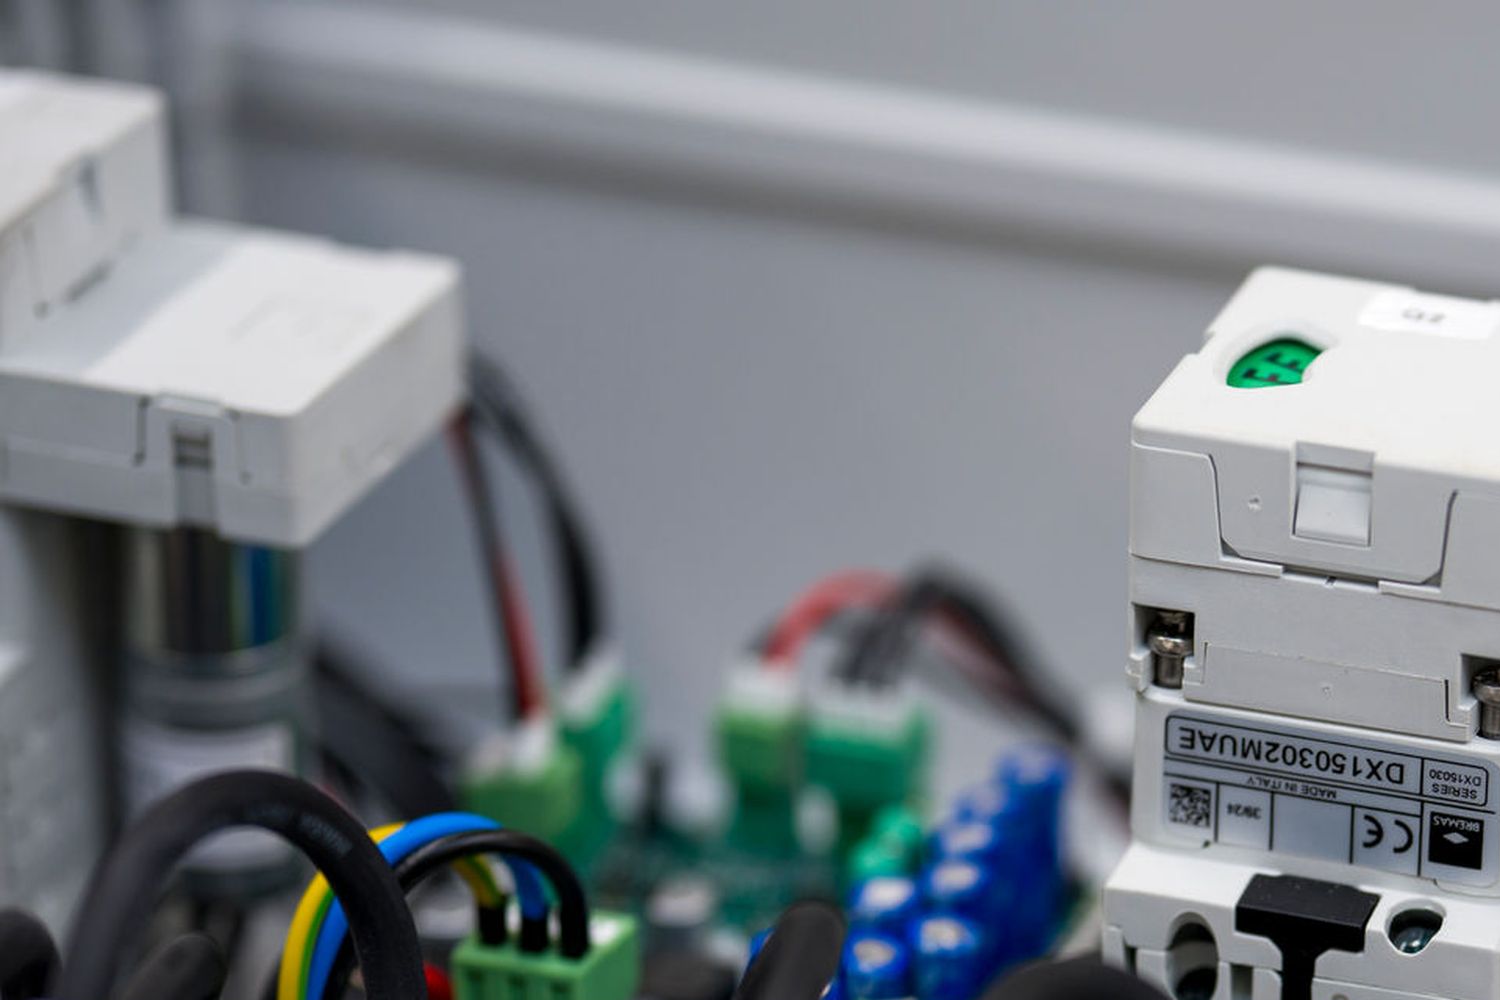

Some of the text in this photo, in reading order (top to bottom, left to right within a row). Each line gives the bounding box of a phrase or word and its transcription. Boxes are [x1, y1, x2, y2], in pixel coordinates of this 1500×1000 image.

[1178, 726, 1406, 785] DX150302MUAE
[1245, 774, 1337, 800] MADE IN ITALY
[1428, 768, 1482, 787] DX15030
[1431, 783, 1478, 801] SERIES
[1432, 815, 1481, 832] BREMAS
